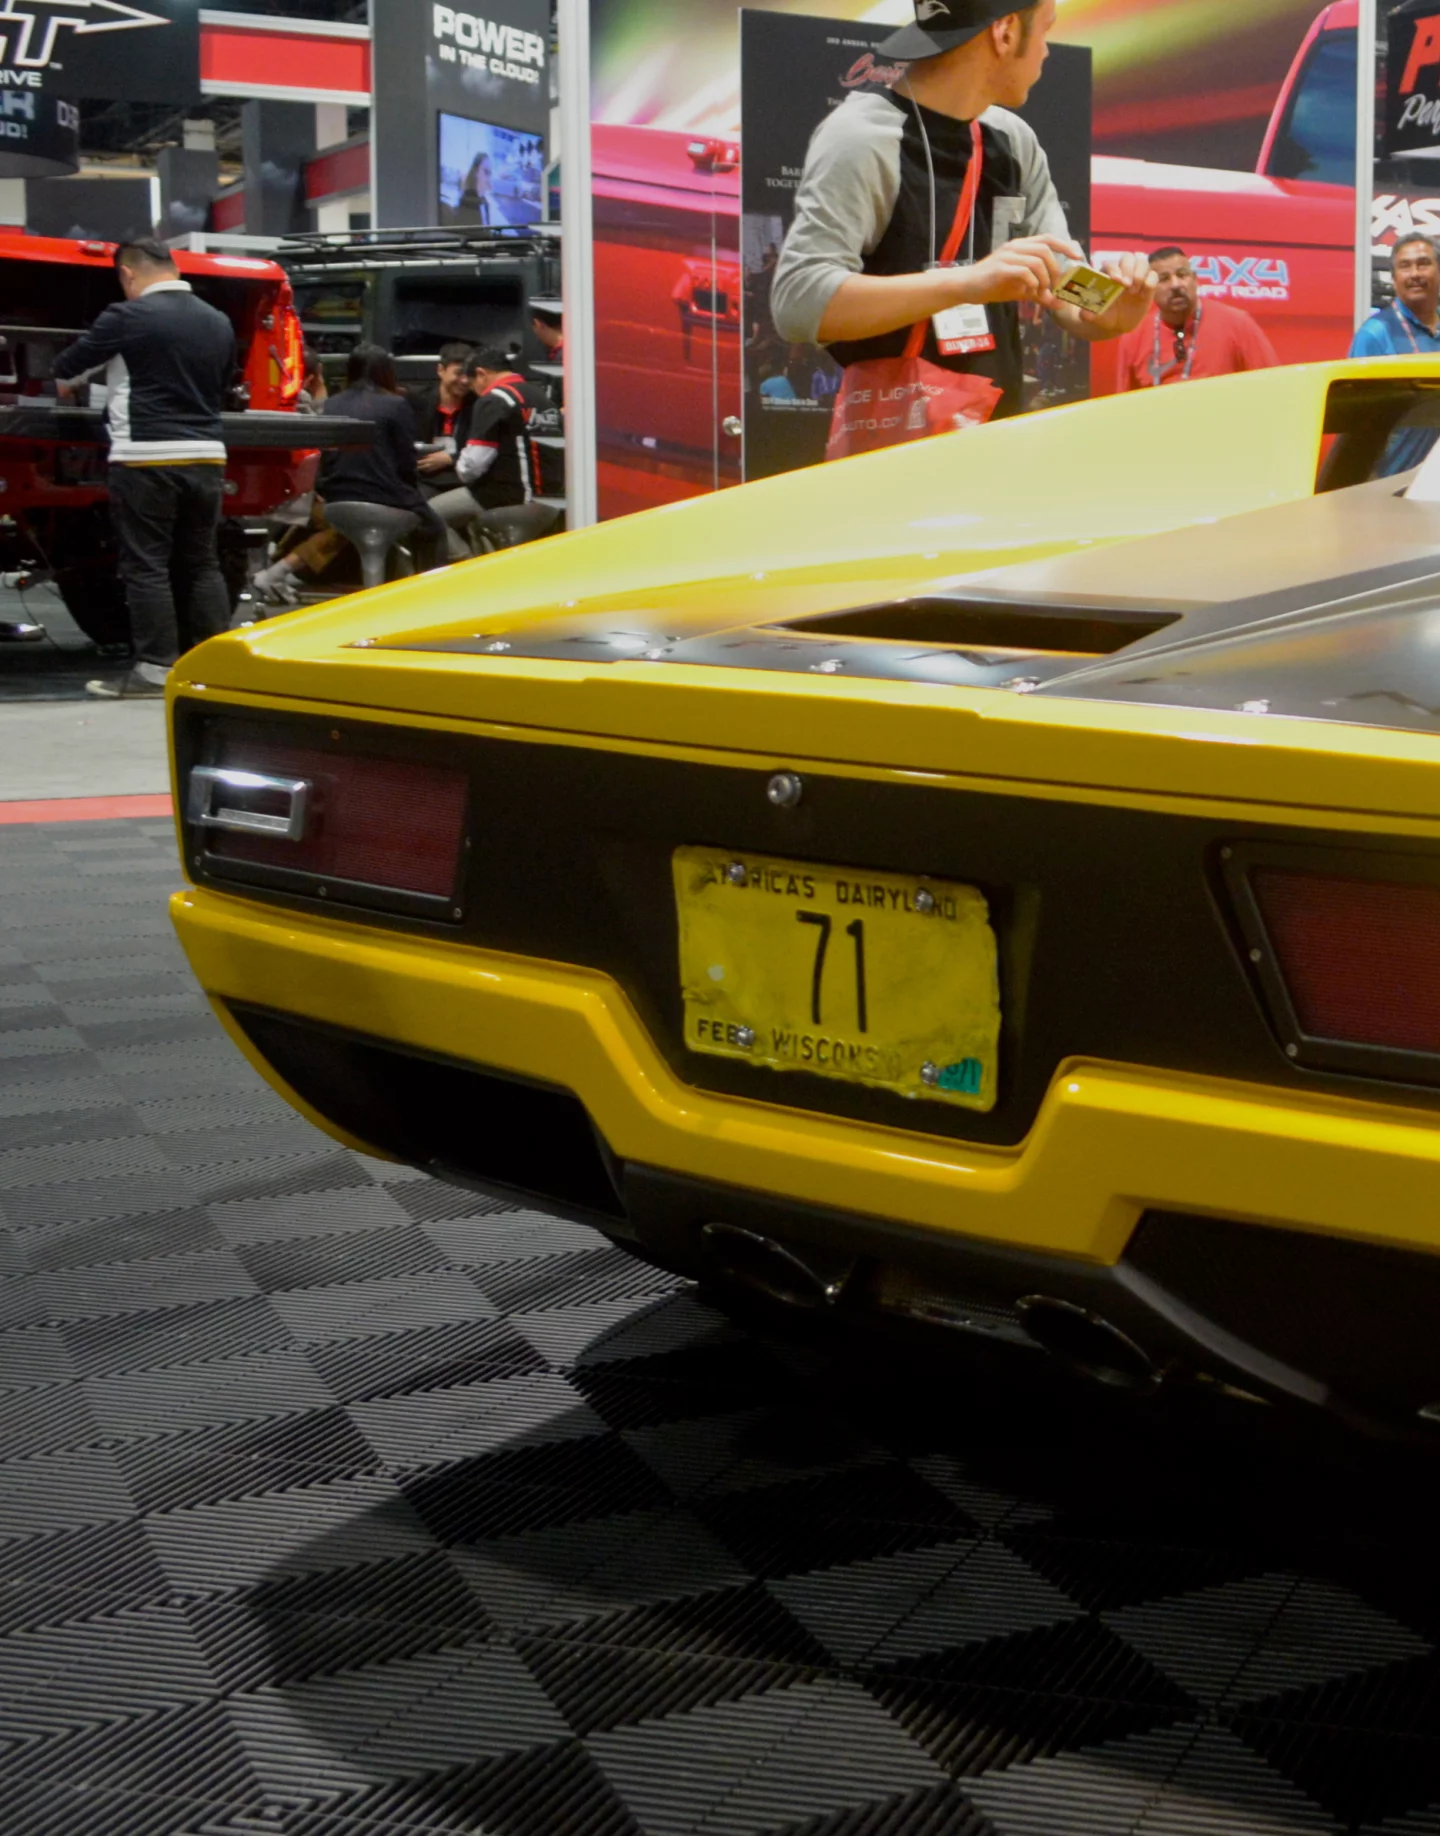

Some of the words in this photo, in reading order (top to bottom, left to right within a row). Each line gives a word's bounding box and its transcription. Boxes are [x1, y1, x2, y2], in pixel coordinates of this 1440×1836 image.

[433, 2, 545, 68] POWER
[439, 43, 456, 62] IN
[458, 48, 487, 70] THE
[1189, 254, 1289, 287] 4X4
[1231, 285, 1288, 298] ROAD
[836, 880, 958, 921] DAIRYLND
[796, 908, 868, 1034] 71
